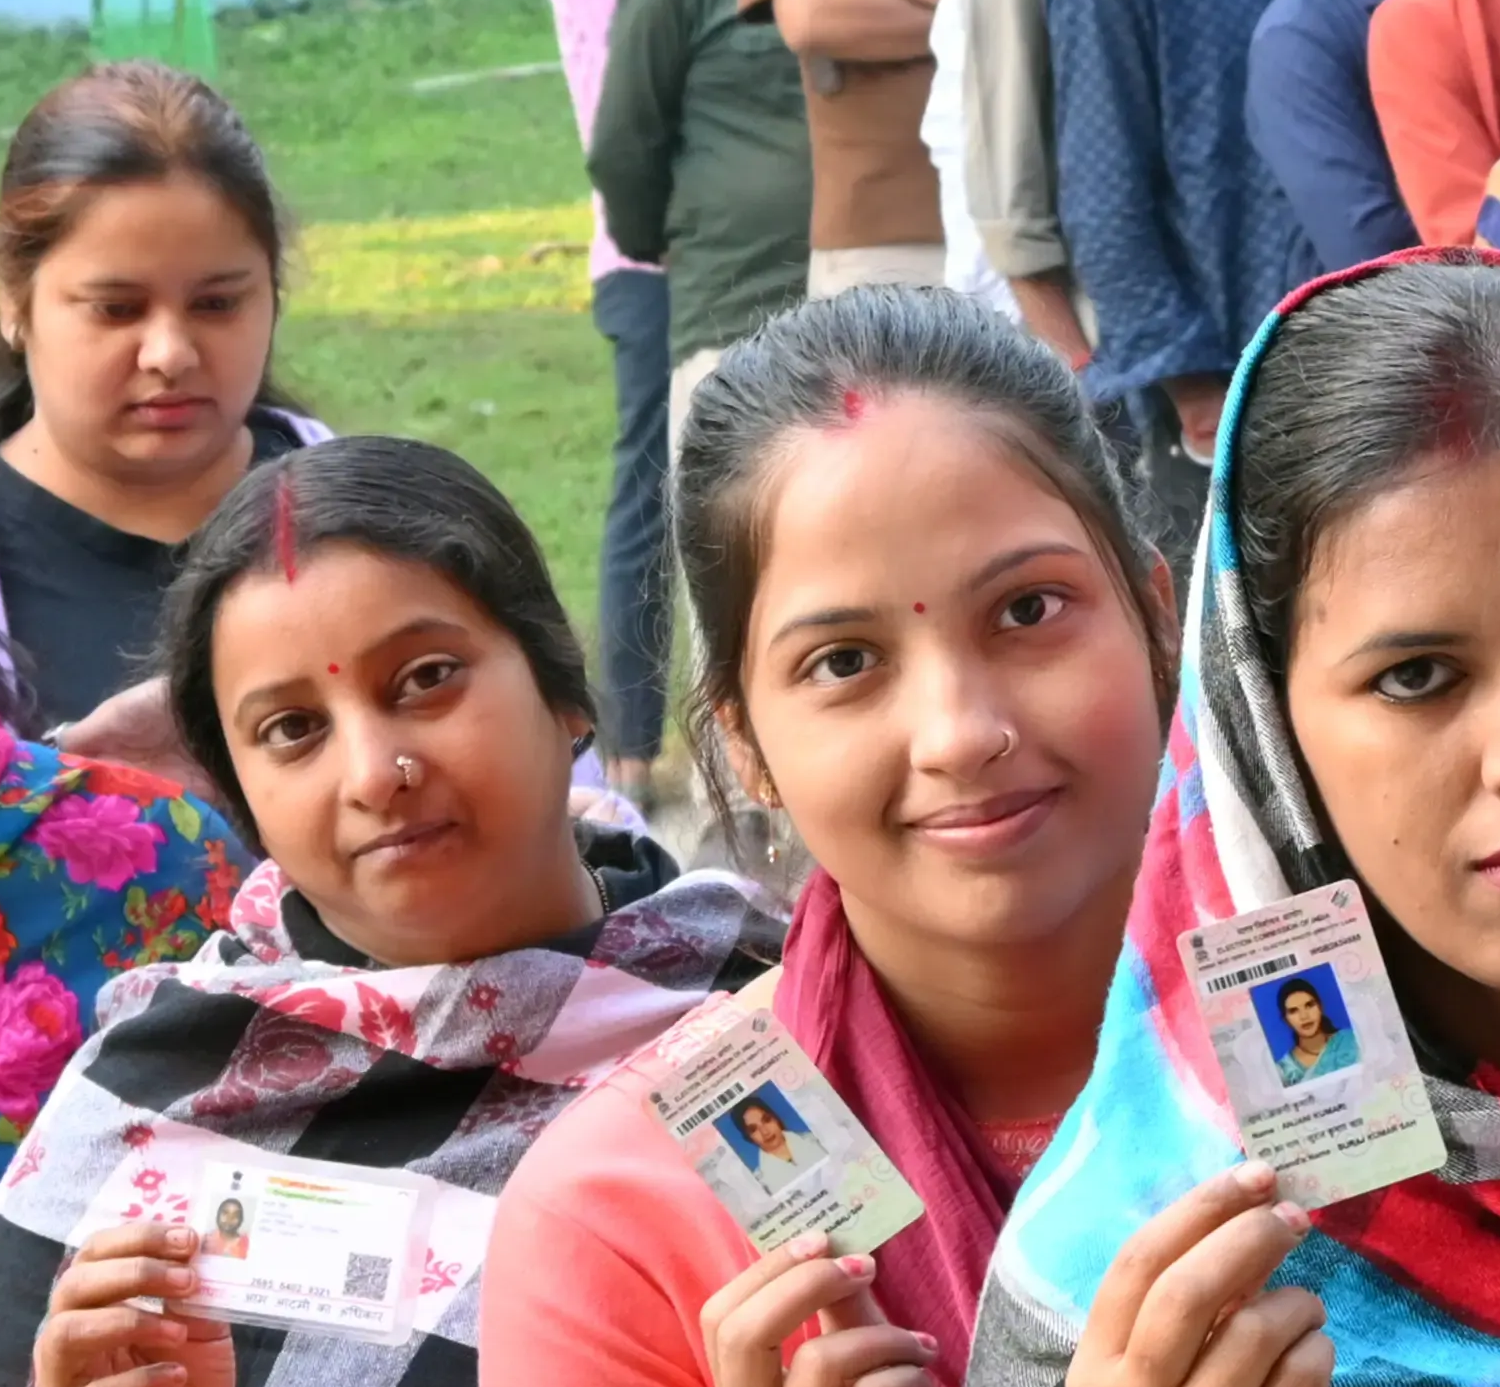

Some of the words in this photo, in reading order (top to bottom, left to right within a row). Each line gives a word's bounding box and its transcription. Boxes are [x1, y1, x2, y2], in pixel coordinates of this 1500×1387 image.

[1216, 937, 1253, 956] ELECTION
[1253, 920, 1299, 943] COMMISSION
[1309, 910, 1331, 924] INDIA
[1251, 1126, 1275, 1140] Name
[1312, 1101, 1347, 1120] KUMARI
